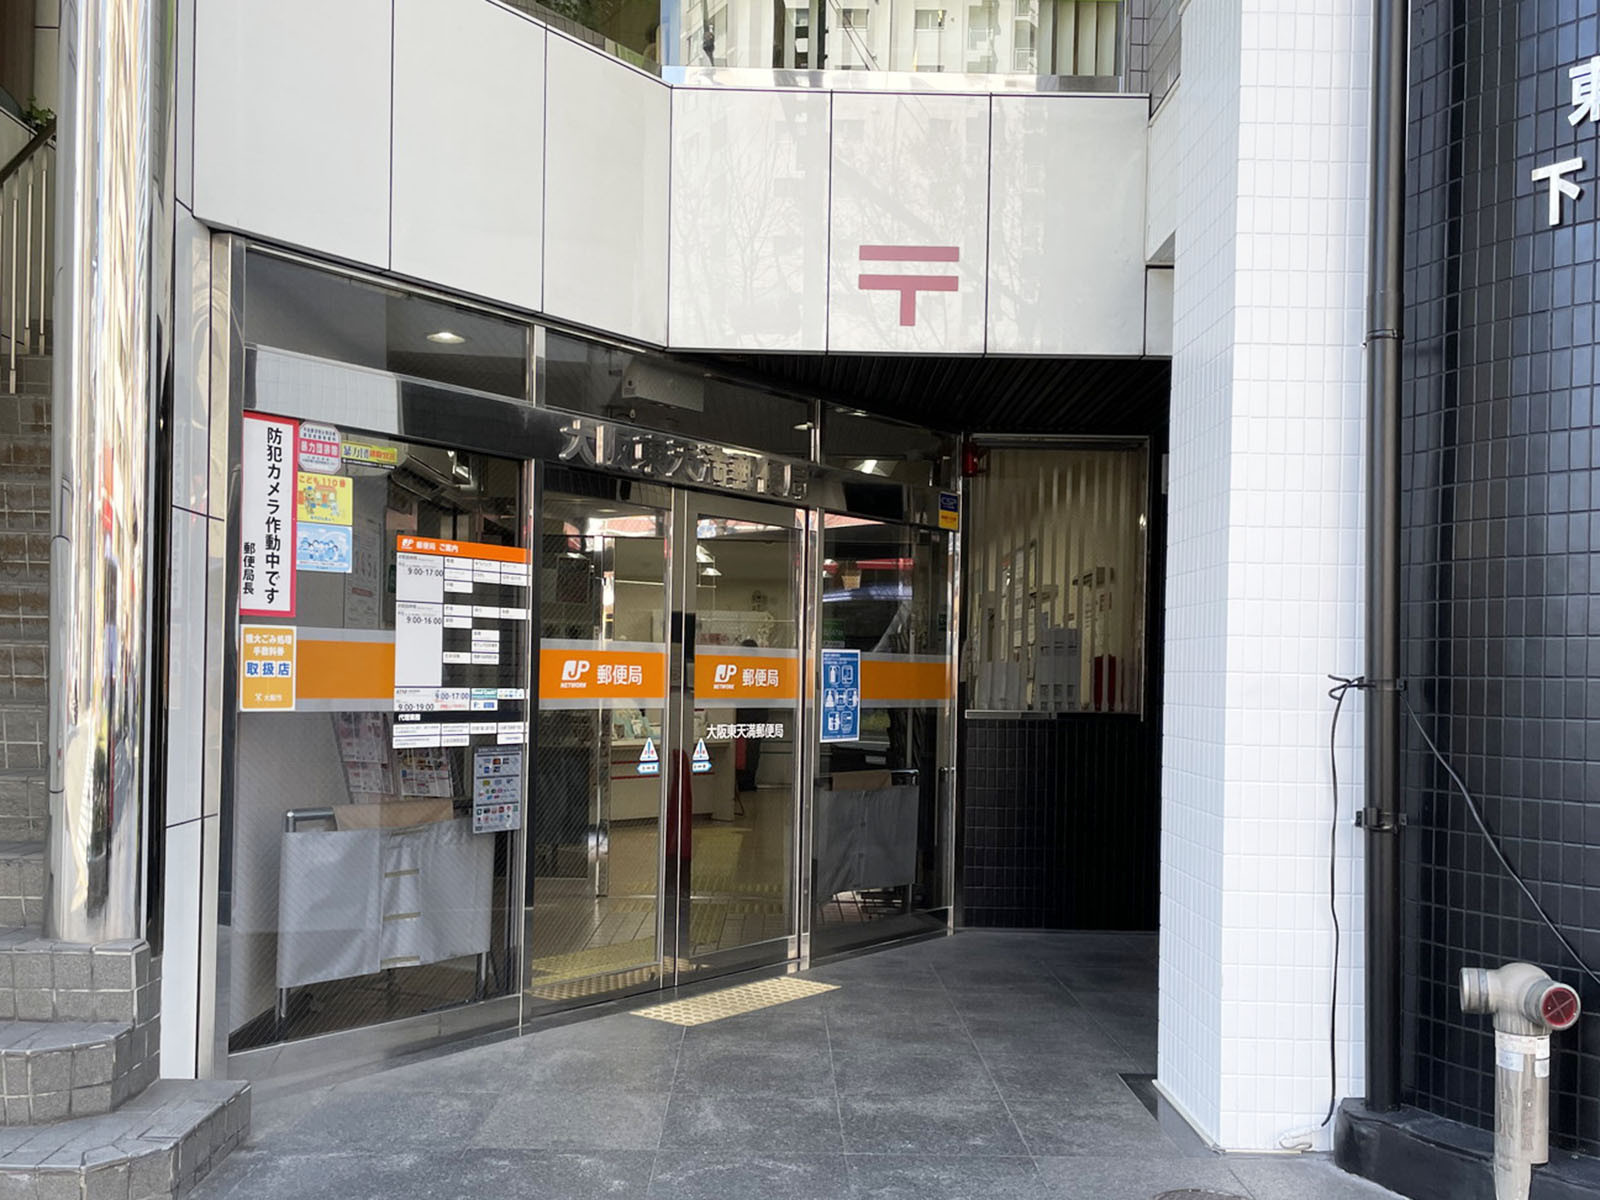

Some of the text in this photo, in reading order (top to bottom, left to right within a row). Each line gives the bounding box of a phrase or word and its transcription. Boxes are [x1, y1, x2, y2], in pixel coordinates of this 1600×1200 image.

[1531, 156, 1584, 226] 下
[265, 427, 283, 604] 防犯カメラ作動中です
[243, 541, 256, 595] 郵便局長
[246, 661, 291, 676] 取扱店
[597, 664, 642, 686] 郵便局
[742, 668, 779, 687] 郵便局
[706, 723, 784, 739] 大阪東天満郵便局
